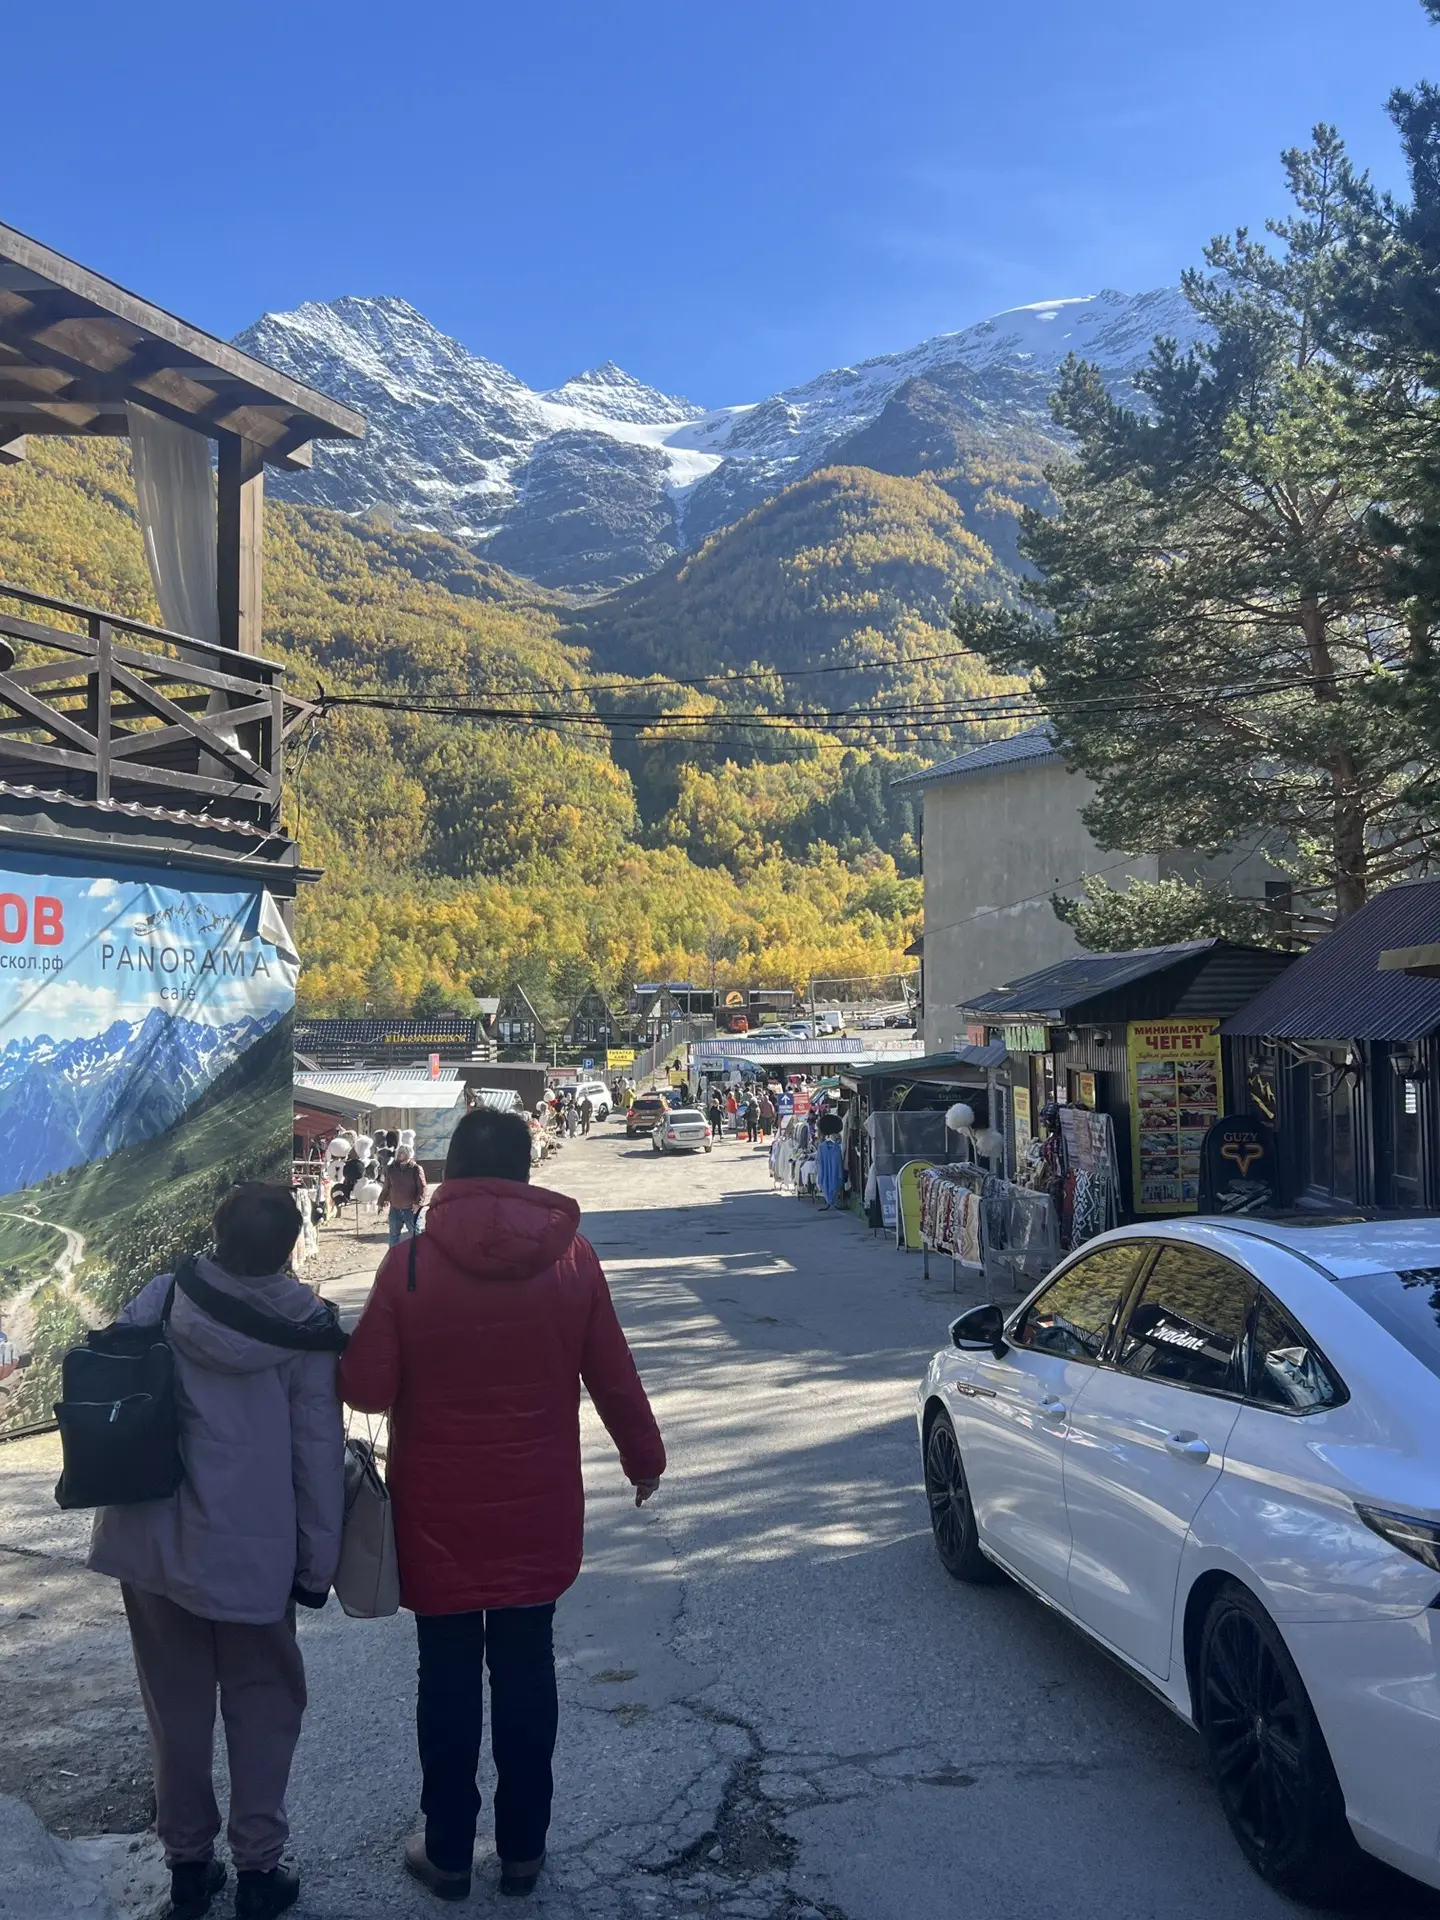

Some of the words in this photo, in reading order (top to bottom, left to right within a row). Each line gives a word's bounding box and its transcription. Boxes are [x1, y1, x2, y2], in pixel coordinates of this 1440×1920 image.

[0, 955, 63, 974] скол.рф
[102, 944, 271, 978] PANORAMA
[1134, 1025, 1214, 1035] МИНИМАРКЕТ
[1145, 1035, 1204, 1050] ЧЕГЕТ
[585, 1060, 592, 1069] P
[1223, 1132, 1259, 1142] GUZY
